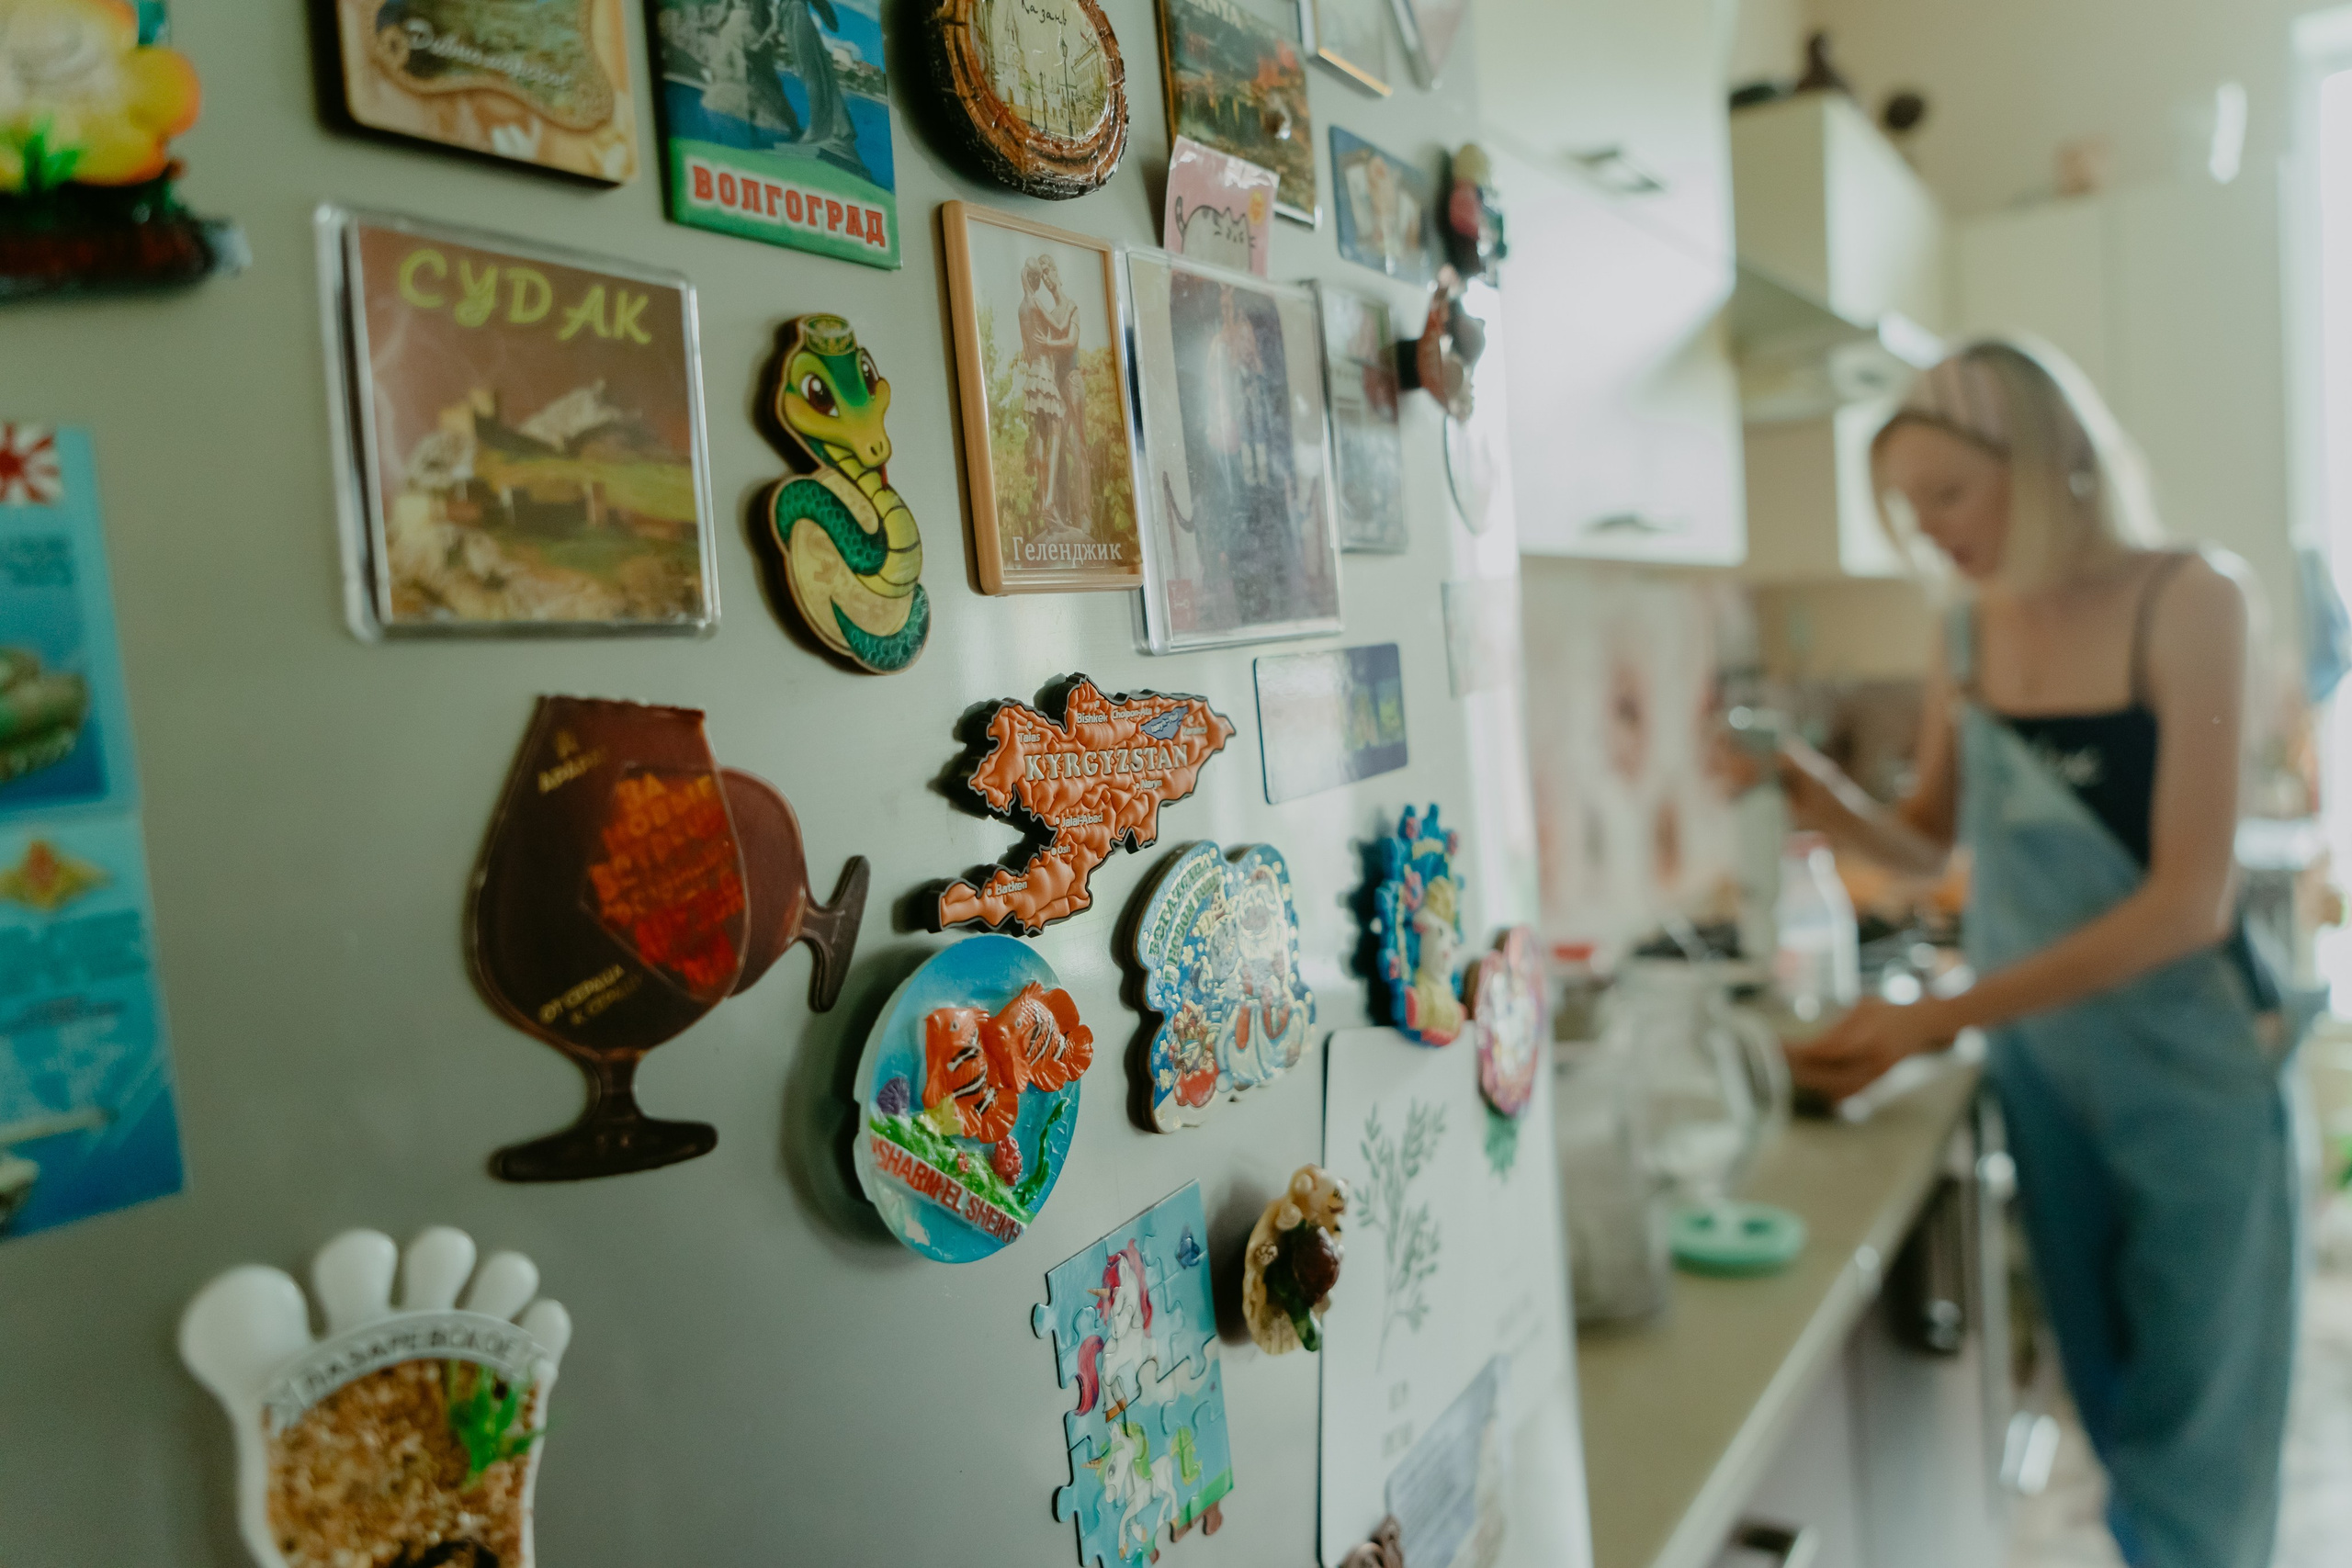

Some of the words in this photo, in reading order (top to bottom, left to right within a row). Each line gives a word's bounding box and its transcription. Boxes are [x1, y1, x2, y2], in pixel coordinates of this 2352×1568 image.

[692, 165, 886, 248] ВОЛГОГРАД
[1012, 536, 1123, 569] Геленджик
[1077, 712, 1108, 724] Bishkek
[1018, 732, 1041, 743] Talas
[1023, 745, 1188, 781] KYRGYZSTAN
[1141, 779, 1163, 790] Naryn
[1061, 813, 1103, 828] Jalal-Abad
[1057, 844, 1071, 854] Osh
[995, 880, 1028, 896] Batken
